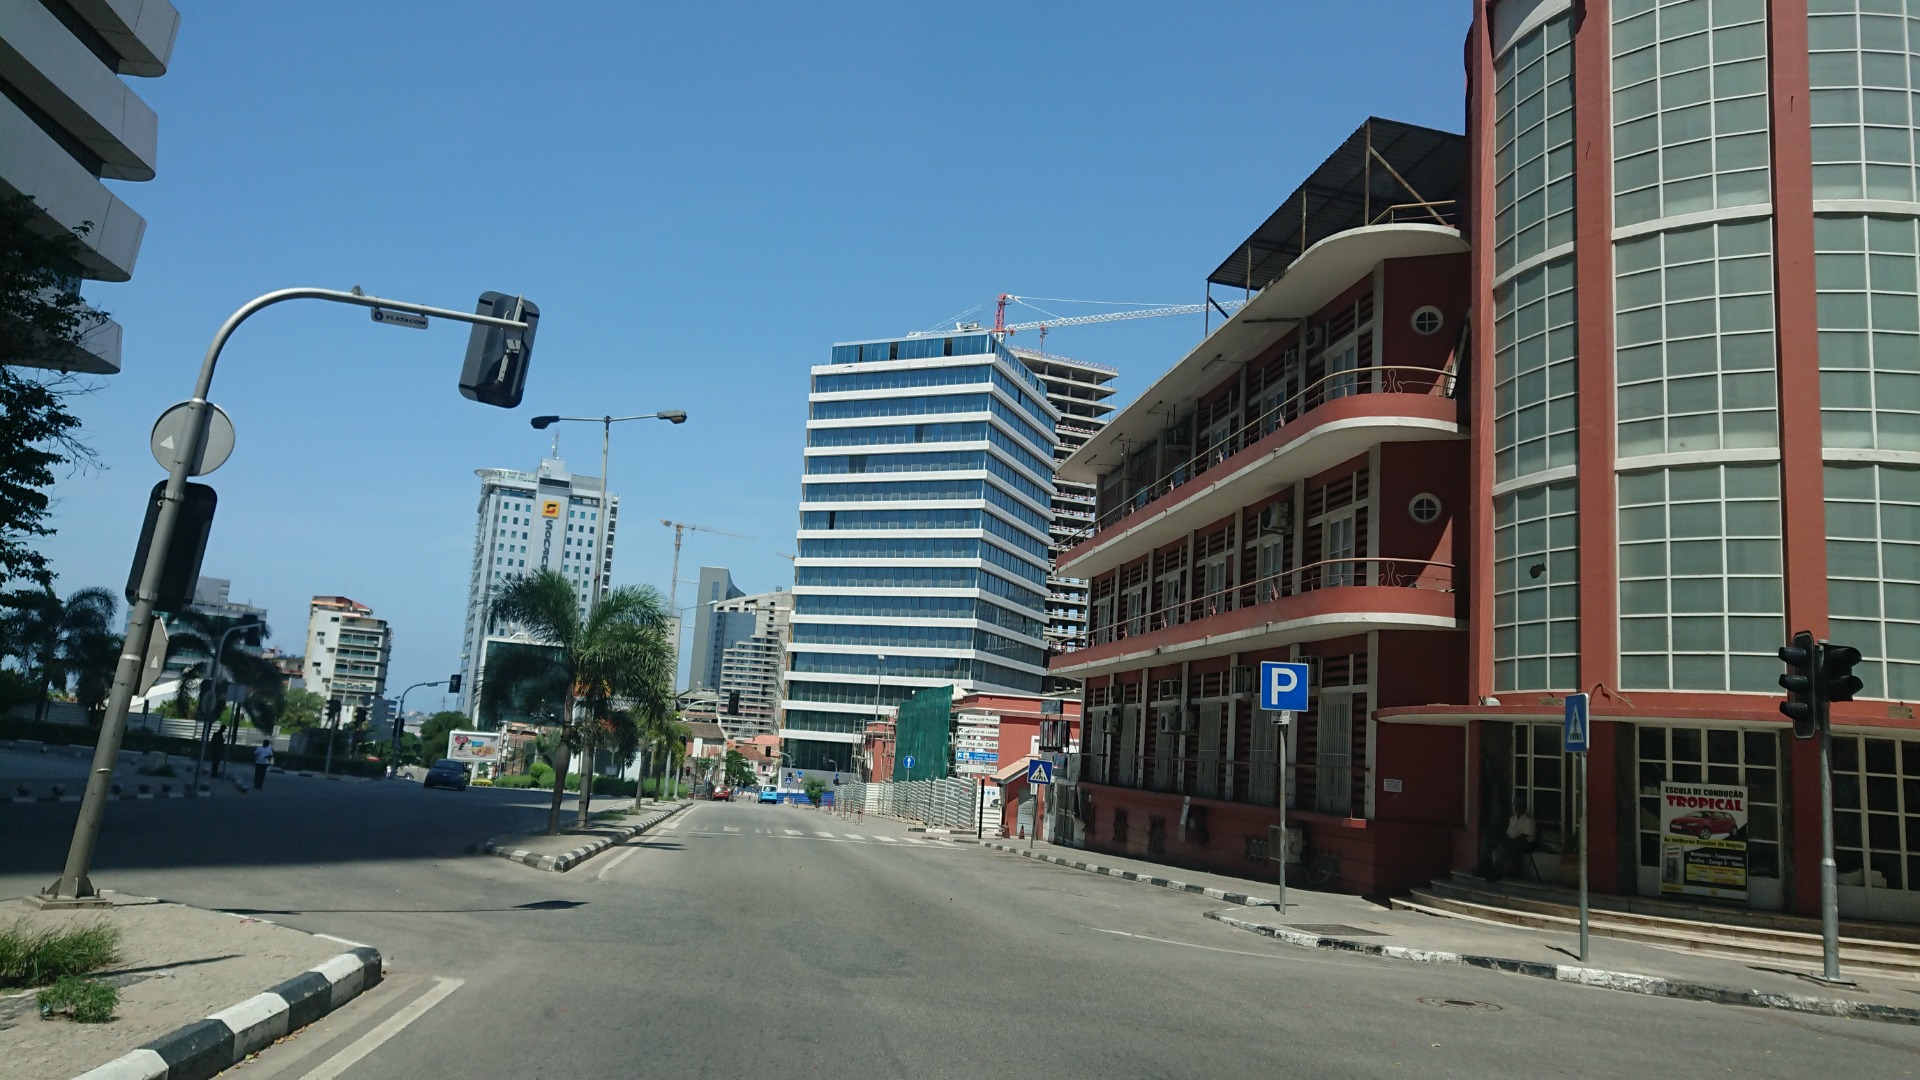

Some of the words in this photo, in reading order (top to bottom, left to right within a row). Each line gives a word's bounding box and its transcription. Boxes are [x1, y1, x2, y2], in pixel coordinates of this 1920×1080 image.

[386, 315, 426, 325] VLATACOM
[1271, 668, 1298, 705] P
[1666, 786, 1692, 795] ESCOLA
[1704, 788, 1744, 798] CONDUÇÃO
[1666, 795, 1744, 811] TROPICAL
